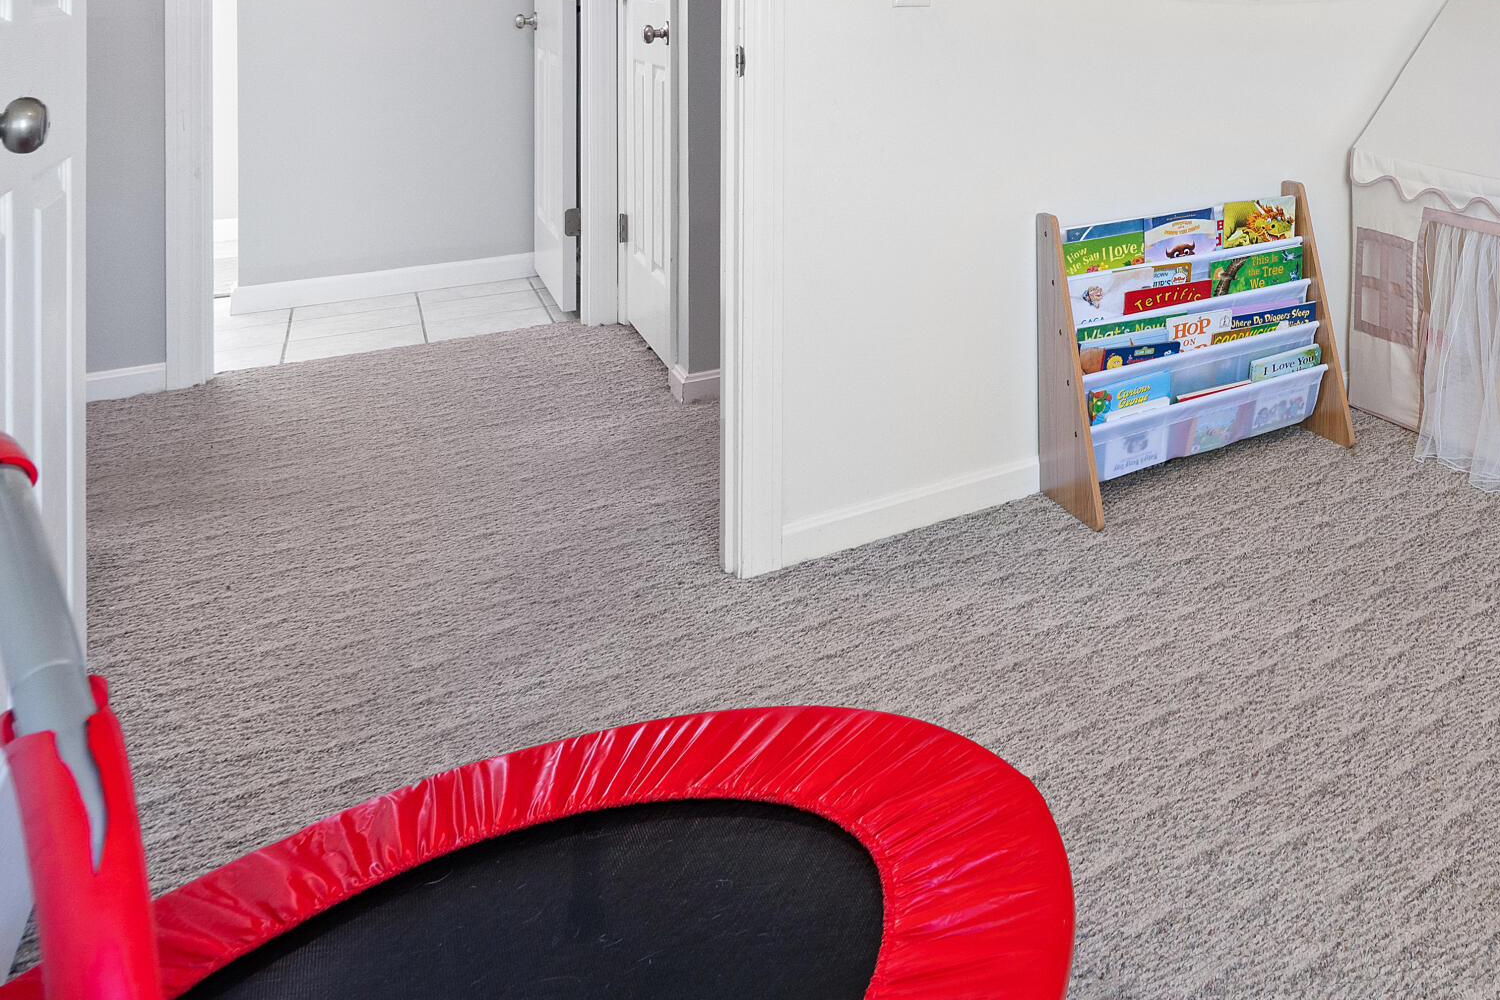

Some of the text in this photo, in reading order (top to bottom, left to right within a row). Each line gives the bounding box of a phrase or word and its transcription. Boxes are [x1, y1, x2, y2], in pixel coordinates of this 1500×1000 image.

[1066, 247, 1087, 264] How
[1108, 243, 1138, 262] Love
[1252, 256, 1270, 266] This
[1262, 265, 1284, 277] Tree
[1250, 277, 1266, 289] We
[1134, 287, 1201, 311] Terrific
[1253, 316, 1263, 324] Do
[1264, 313, 1290, 322] Diggers
[1291, 308, 1310, 319] Sleep
[1173, 318, 1211, 340] HOP
[1183, 337, 1196, 346] ON
[1263, 366, 1268, 376] I
[1272, 362, 1295, 372] Love
[1297, 356, 1314, 366] You
[1116, 385, 1151, 400] Curious
